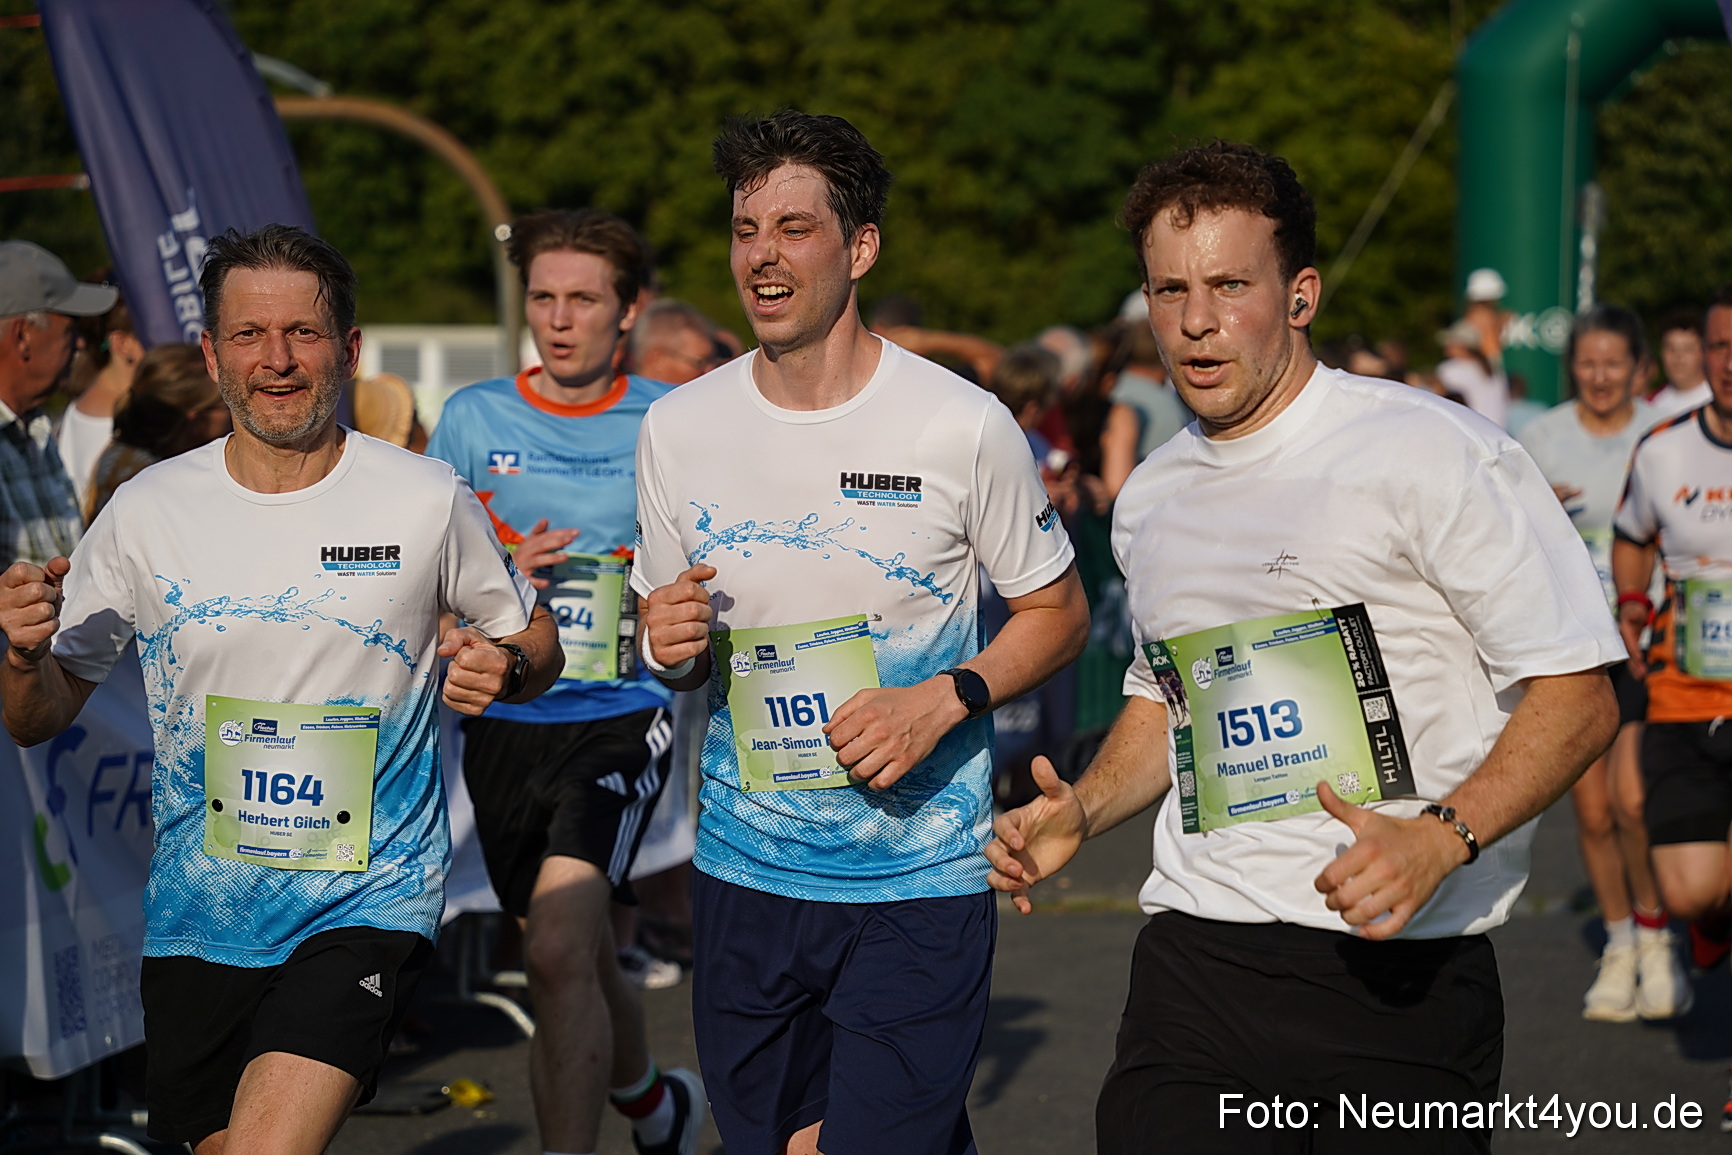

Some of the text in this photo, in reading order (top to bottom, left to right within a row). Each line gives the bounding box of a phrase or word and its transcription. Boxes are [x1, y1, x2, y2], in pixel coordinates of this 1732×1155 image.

[158, 230, 206, 346] OBILE
[840, 472, 922, 492] HUBER
[857, 491, 918, 500] TECHNOLOGY
[320, 545, 400, 562] HUBER
[337, 562, 398, 570] TECHNOLOGY
[1348, 616, 1364, 648] OUTLET
[1152, 655, 1170, 667] AOK
[1337, 618, 1366, 688] 20 % RABATT
[753, 657, 795, 670] Firmenlauf
[770, 666, 796, 674] neumarkt
[1214, 659, 1251, 679] Firmenlauf
[1359, 648, 1374, 686] FACTORY
[1228, 670, 1252, 681] neumarkt
[764, 692, 830, 728] 1161
[1218, 700, 1303, 748] 1513
[244, 734, 296, 744] Firmenlauf
[752, 737, 822, 751] Jean-Simon
[1217, 756, 1269, 778] Manuel
[1272, 744, 1328, 768] Brandl
[1375, 725, 1398, 784] HILTL
[88, 753, 154, 838] FR
[242, 769, 324, 806] 1164
[238, 810, 330, 829] Herbert Gilch
[239, 846, 287, 858] firmenlauf.bayern
[359, 980, 382, 997] adidas
